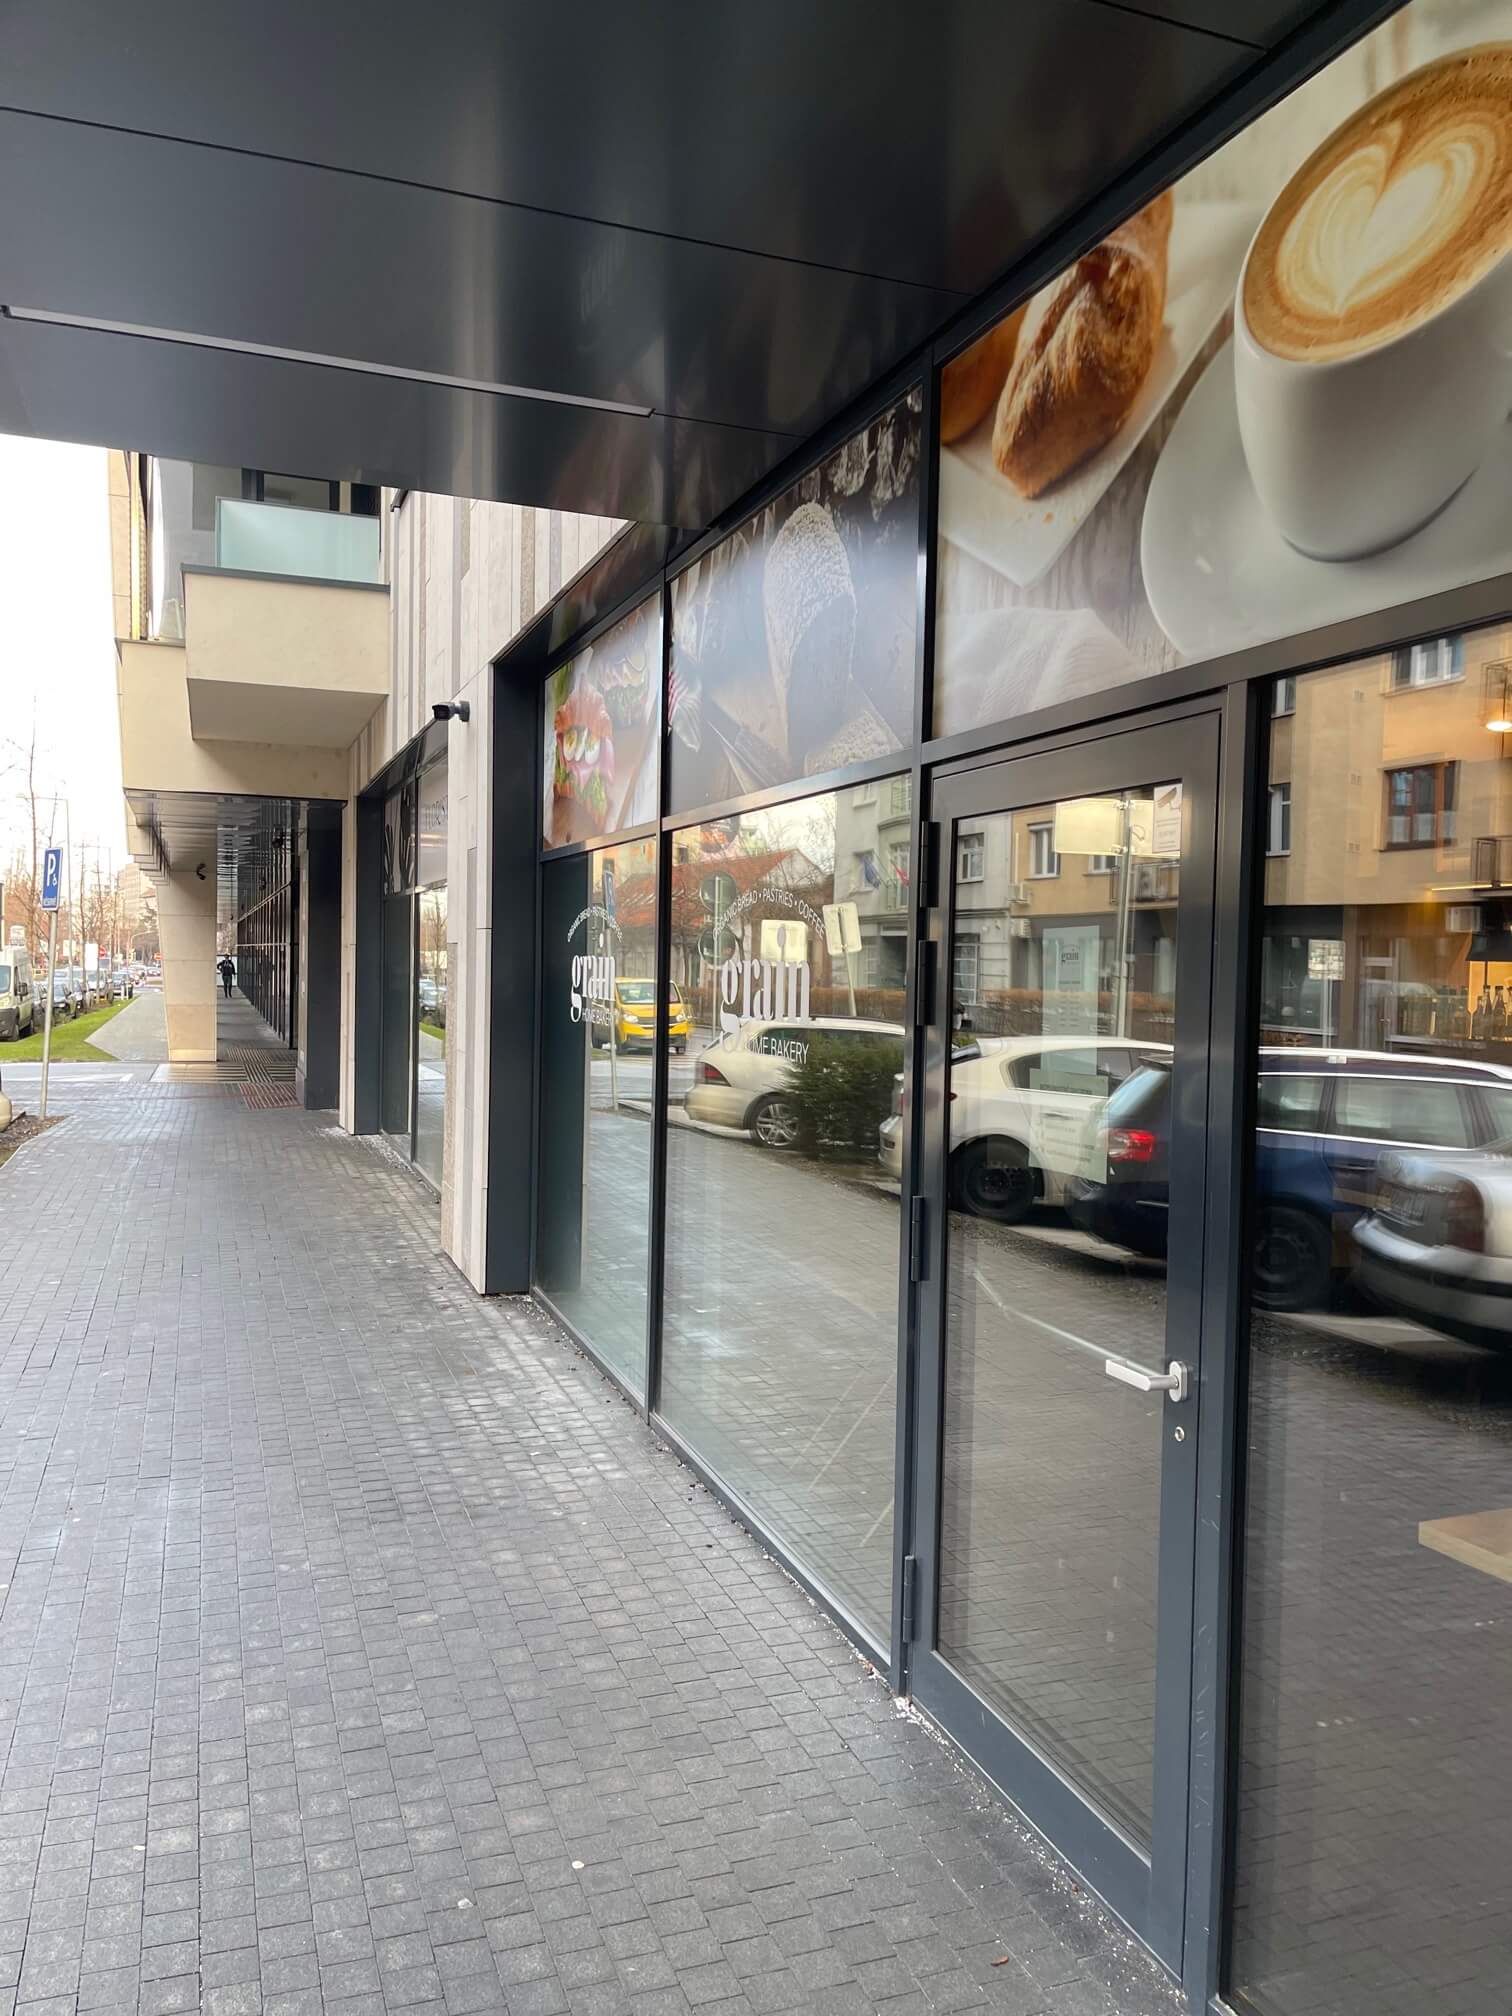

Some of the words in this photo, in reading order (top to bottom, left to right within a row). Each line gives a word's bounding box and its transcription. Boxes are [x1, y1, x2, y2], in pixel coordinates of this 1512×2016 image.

[47, 854, 56, 887] P
[737, 890, 758, 911] BREAD
[763, 888, 794, 908] PASTRIES
[798, 900, 825, 939] COFFEE
[571, 933, 616, 1023] grain
[719, 927, 810, 1053] grain
[771, 1038, 810, 1065] BAKERY
